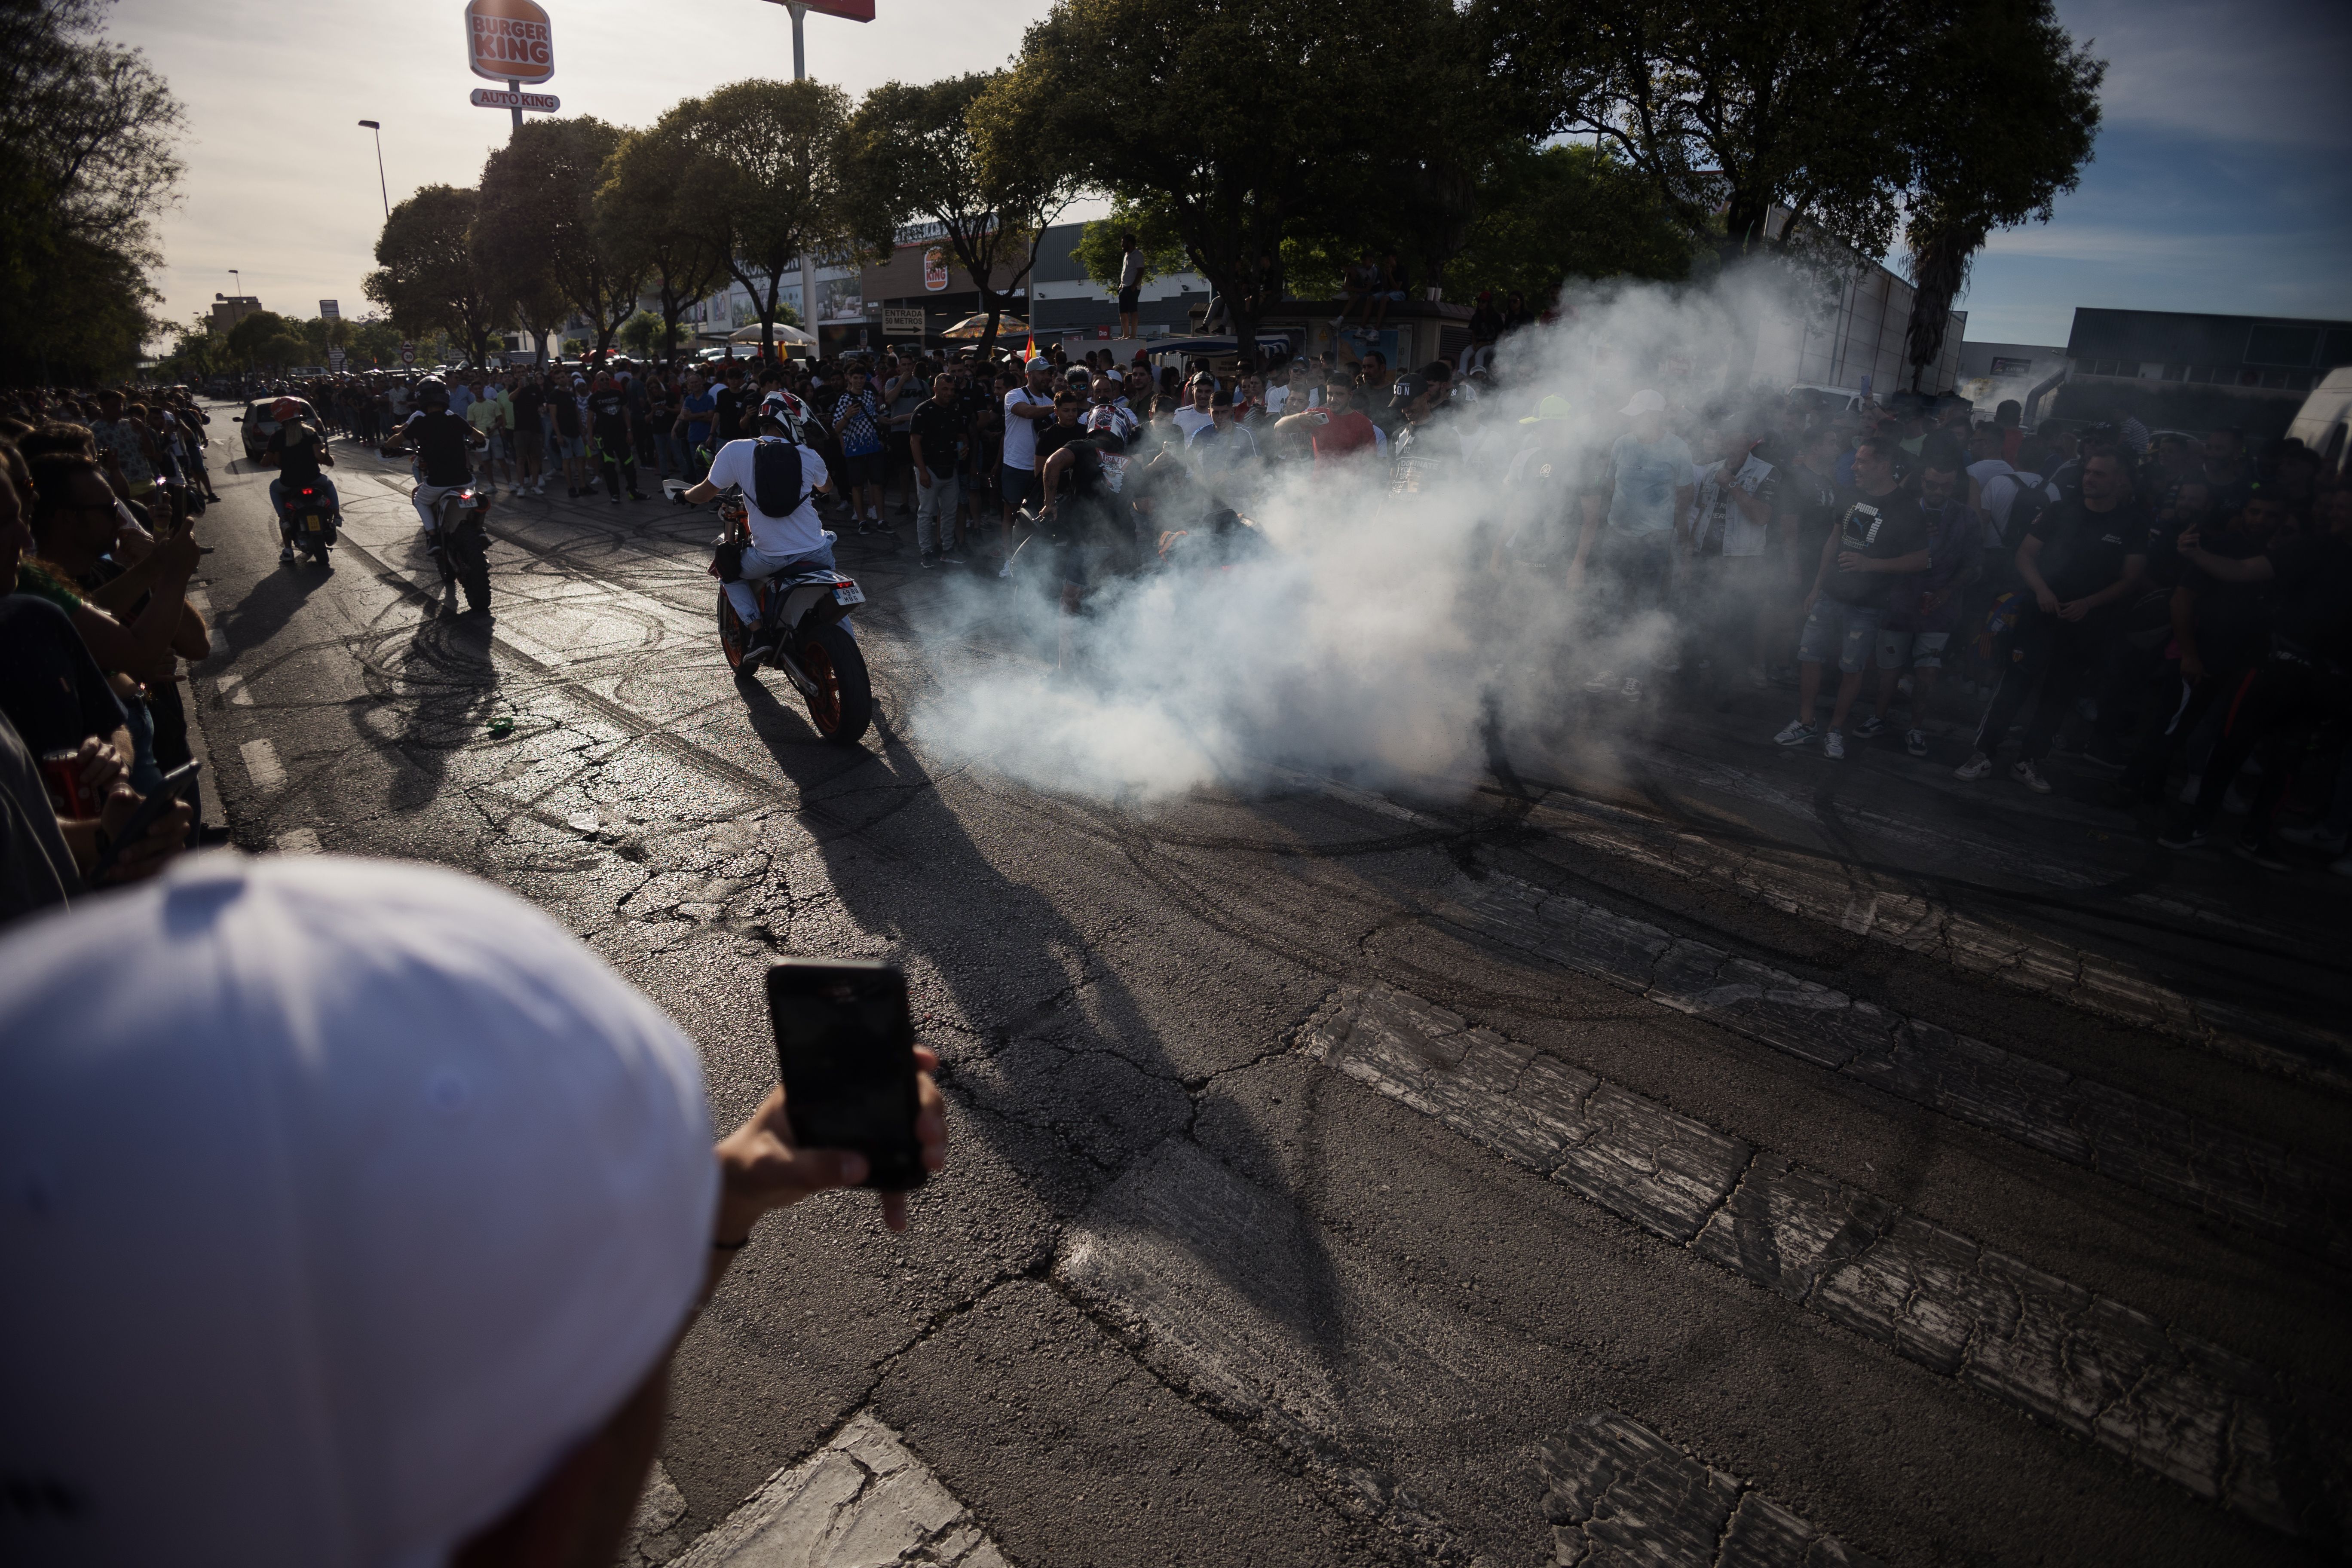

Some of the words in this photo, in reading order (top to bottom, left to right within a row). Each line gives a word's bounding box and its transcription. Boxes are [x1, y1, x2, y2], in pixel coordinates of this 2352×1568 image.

[473, 16, 548, 41] BURGER
[474, 33, 550, 64] KING
[481, 91, 519, 104] AUTO
[521, 95, 554, 108] KING
[927, 269, 946, 281] KING
[1012, 288, 1025, 297] ING
[1400, 460, 1439, 470] DOMINATE
[1855, 502, 1879, 517] PUMA
[1865, 517, 1883, 543] PUMA
